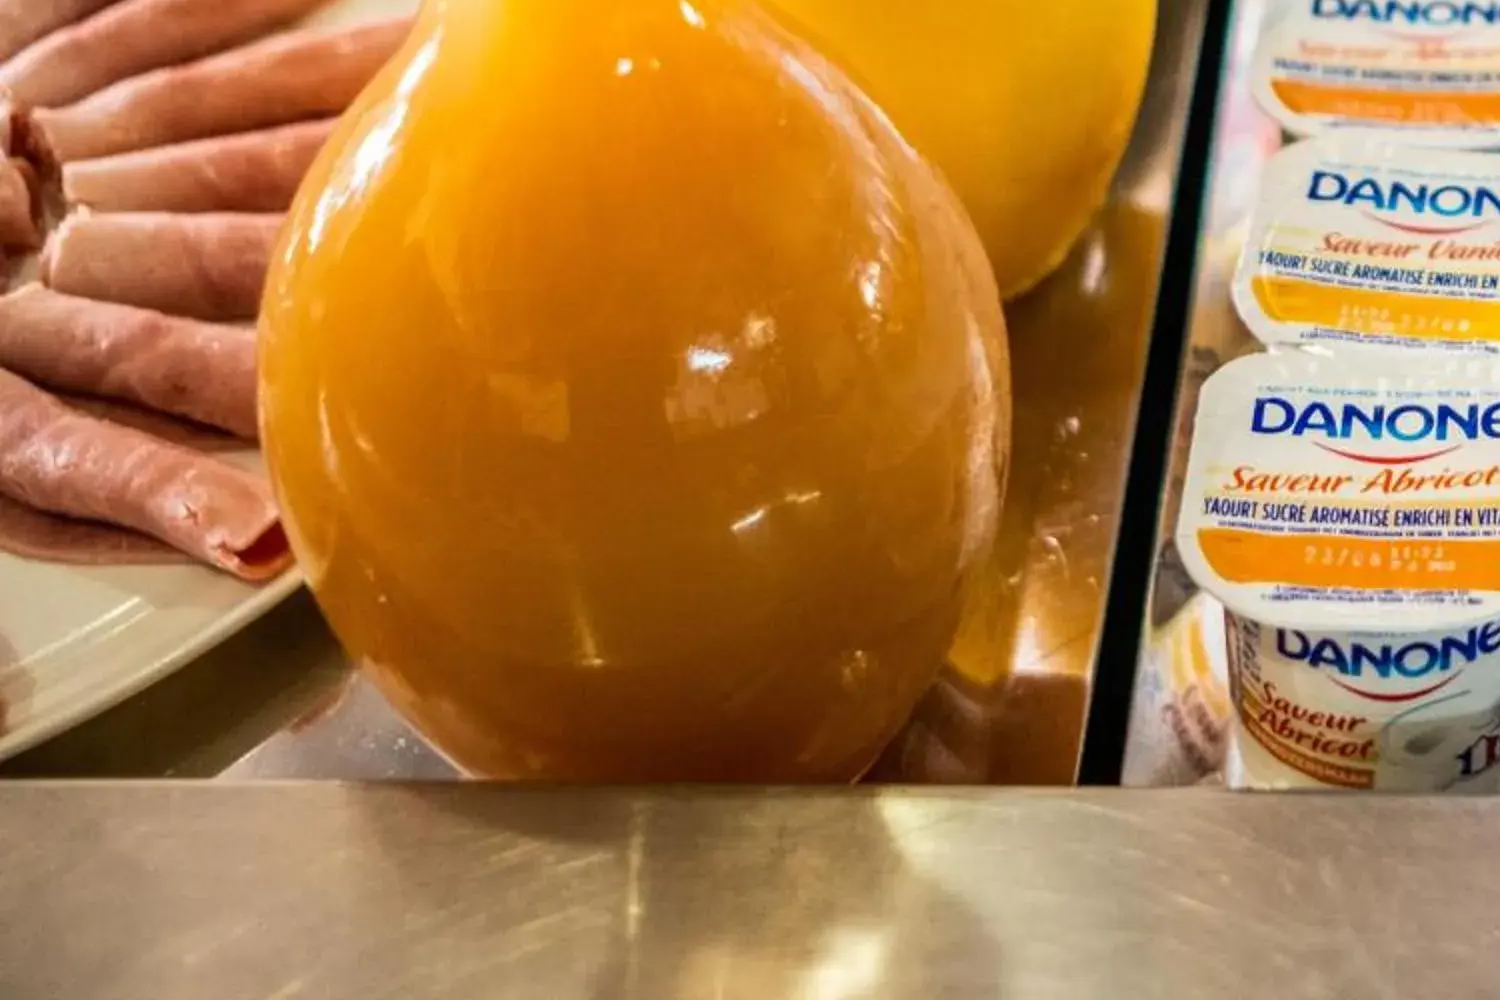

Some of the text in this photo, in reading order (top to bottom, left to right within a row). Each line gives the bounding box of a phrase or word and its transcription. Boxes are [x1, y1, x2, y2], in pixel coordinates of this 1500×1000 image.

[1315, 231, 1420, 258] Saveur
[1427, 270, 1478, 288] ENRICHI
[1481, 273, 1498, 289] EN
[1223, 465, 1500, 493] Saveur Abricot
[1203, 497, 1258, 517] YAOURT
[1393, 507, 1450, 527] ENRICHI
[1454, 506, 1473, 526] EN
[1261, 681, 1368, 732] Saveur
[1260, 708, 1375, 760] Abricot
